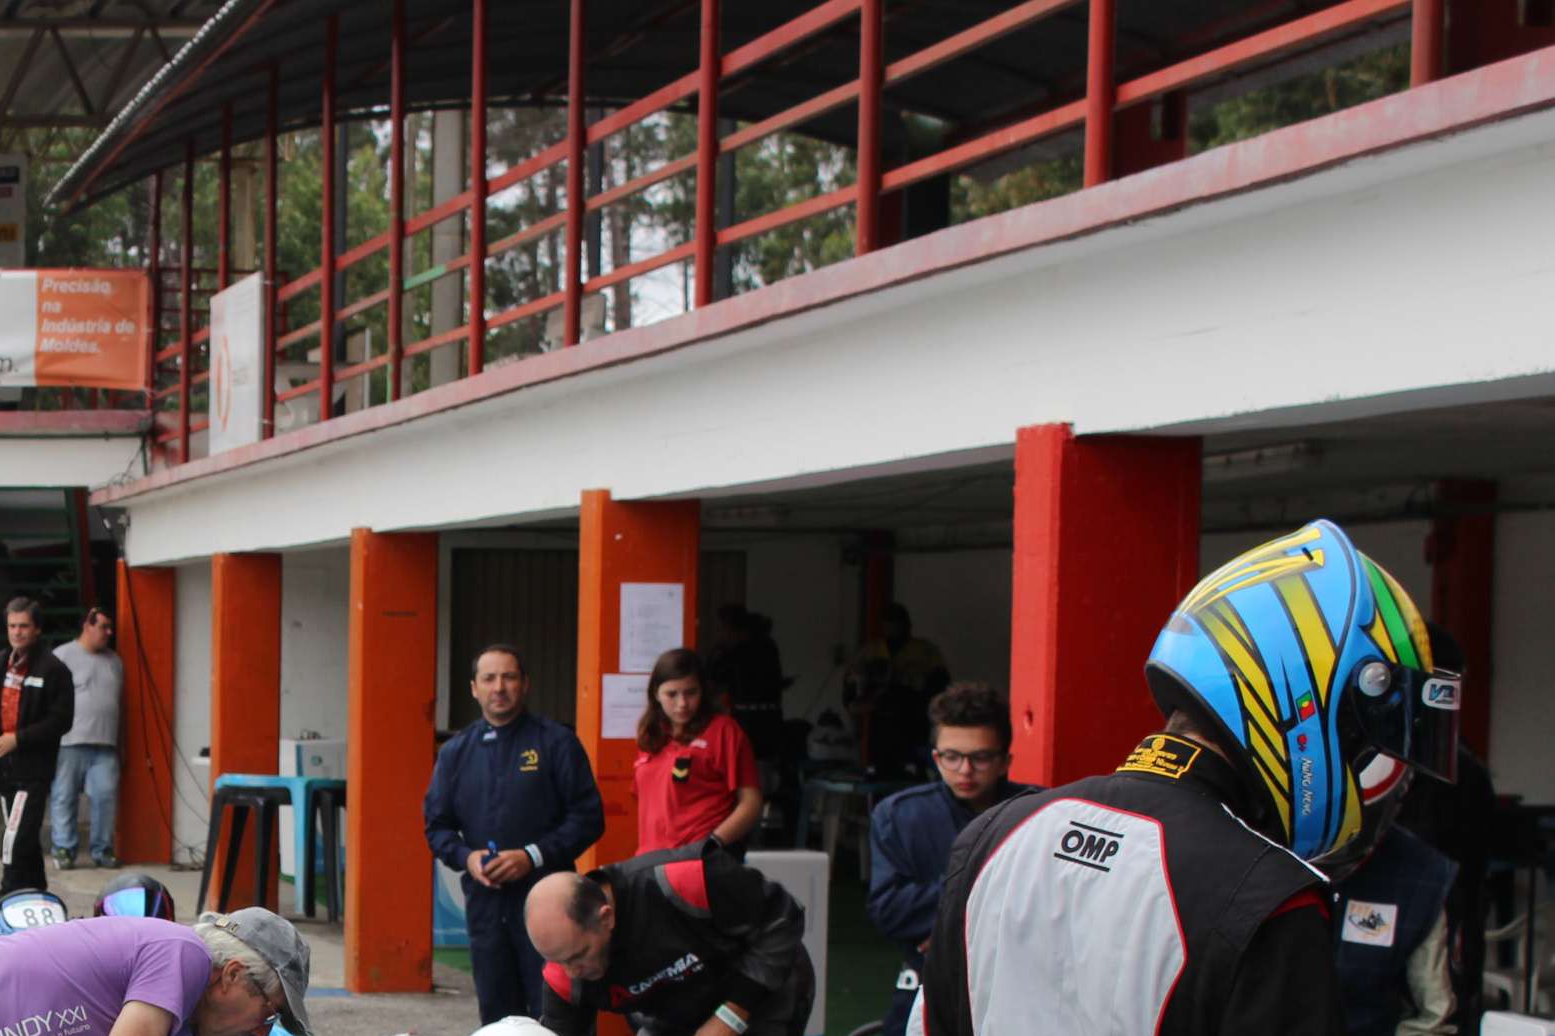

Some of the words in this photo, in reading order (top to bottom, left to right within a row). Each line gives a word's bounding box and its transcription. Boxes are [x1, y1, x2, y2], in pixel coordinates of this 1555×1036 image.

[115, 319, 137, 335] de
[1061, 829, 1120, 863] OMP
[54, 1005, 88, 1030] XXI
